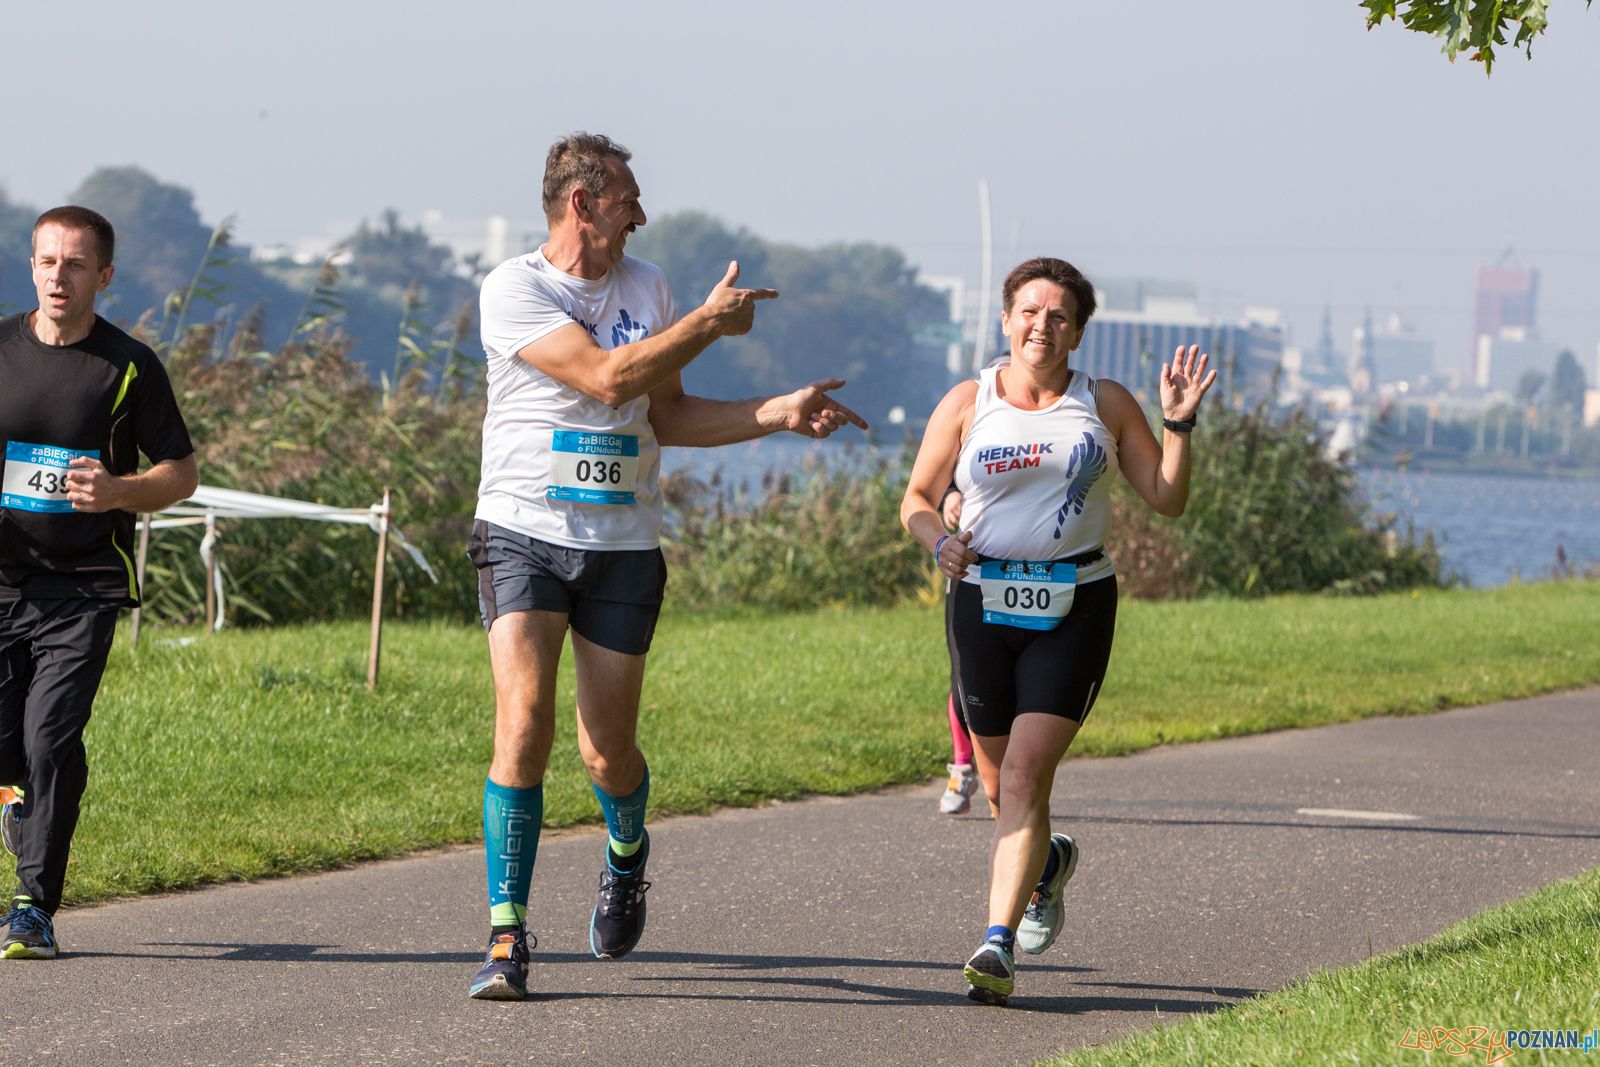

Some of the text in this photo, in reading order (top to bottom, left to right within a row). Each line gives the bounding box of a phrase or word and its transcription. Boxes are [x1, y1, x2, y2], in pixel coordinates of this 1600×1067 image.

[578, 435, 623, 448] zaBIEGaj
[585, 446, 622, 455] FUNdusze
[977, 442, 1054, 463] HERNIK
[38, 456, 75, 468] FUNdusz
[984, 456, 1041, 475] TEAM
[576, 459, 621, 485] 036
[1012, 572, 1052, 581] FUNdusze
[1004, 586, 1051, 610] 030
